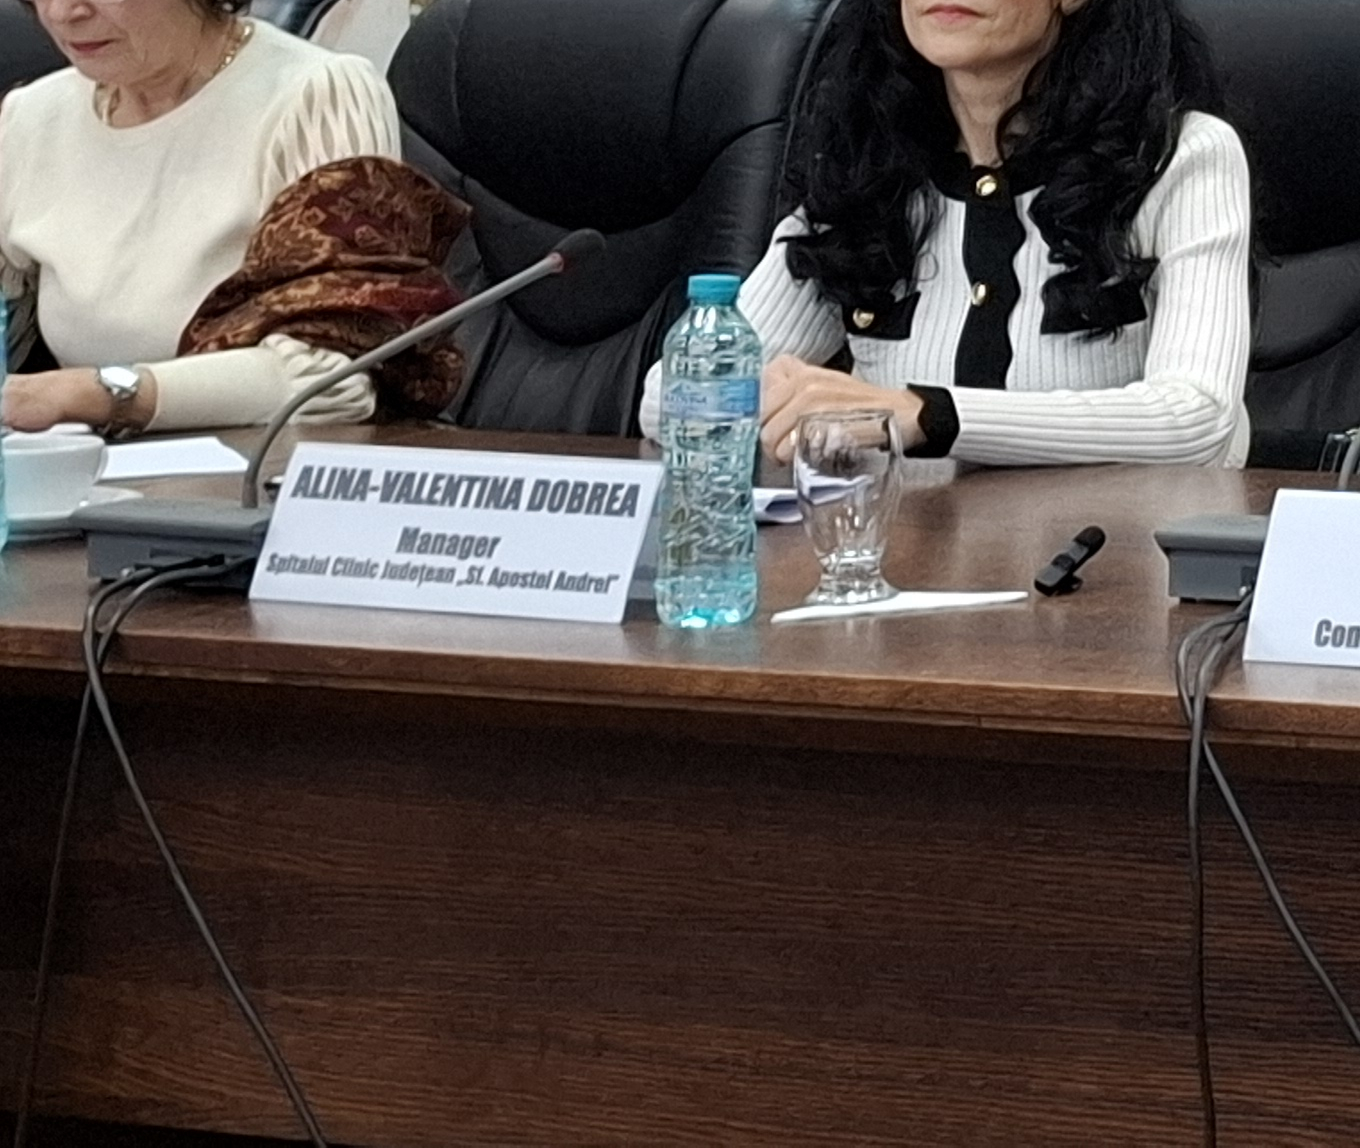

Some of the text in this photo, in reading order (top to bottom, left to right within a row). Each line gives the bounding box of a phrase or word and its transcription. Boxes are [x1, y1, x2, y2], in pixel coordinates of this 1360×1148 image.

[291, 464, 643, 519] ALINA-VALENTINA DOBREA
[395, 525, 501, 559] Manager
[265, 552, 330, 577] Spitalul
[331, 556, 380, 579] Clinic
[381, 559, 455, 588] Județean
[487, 567, 553, 592] Apostol
